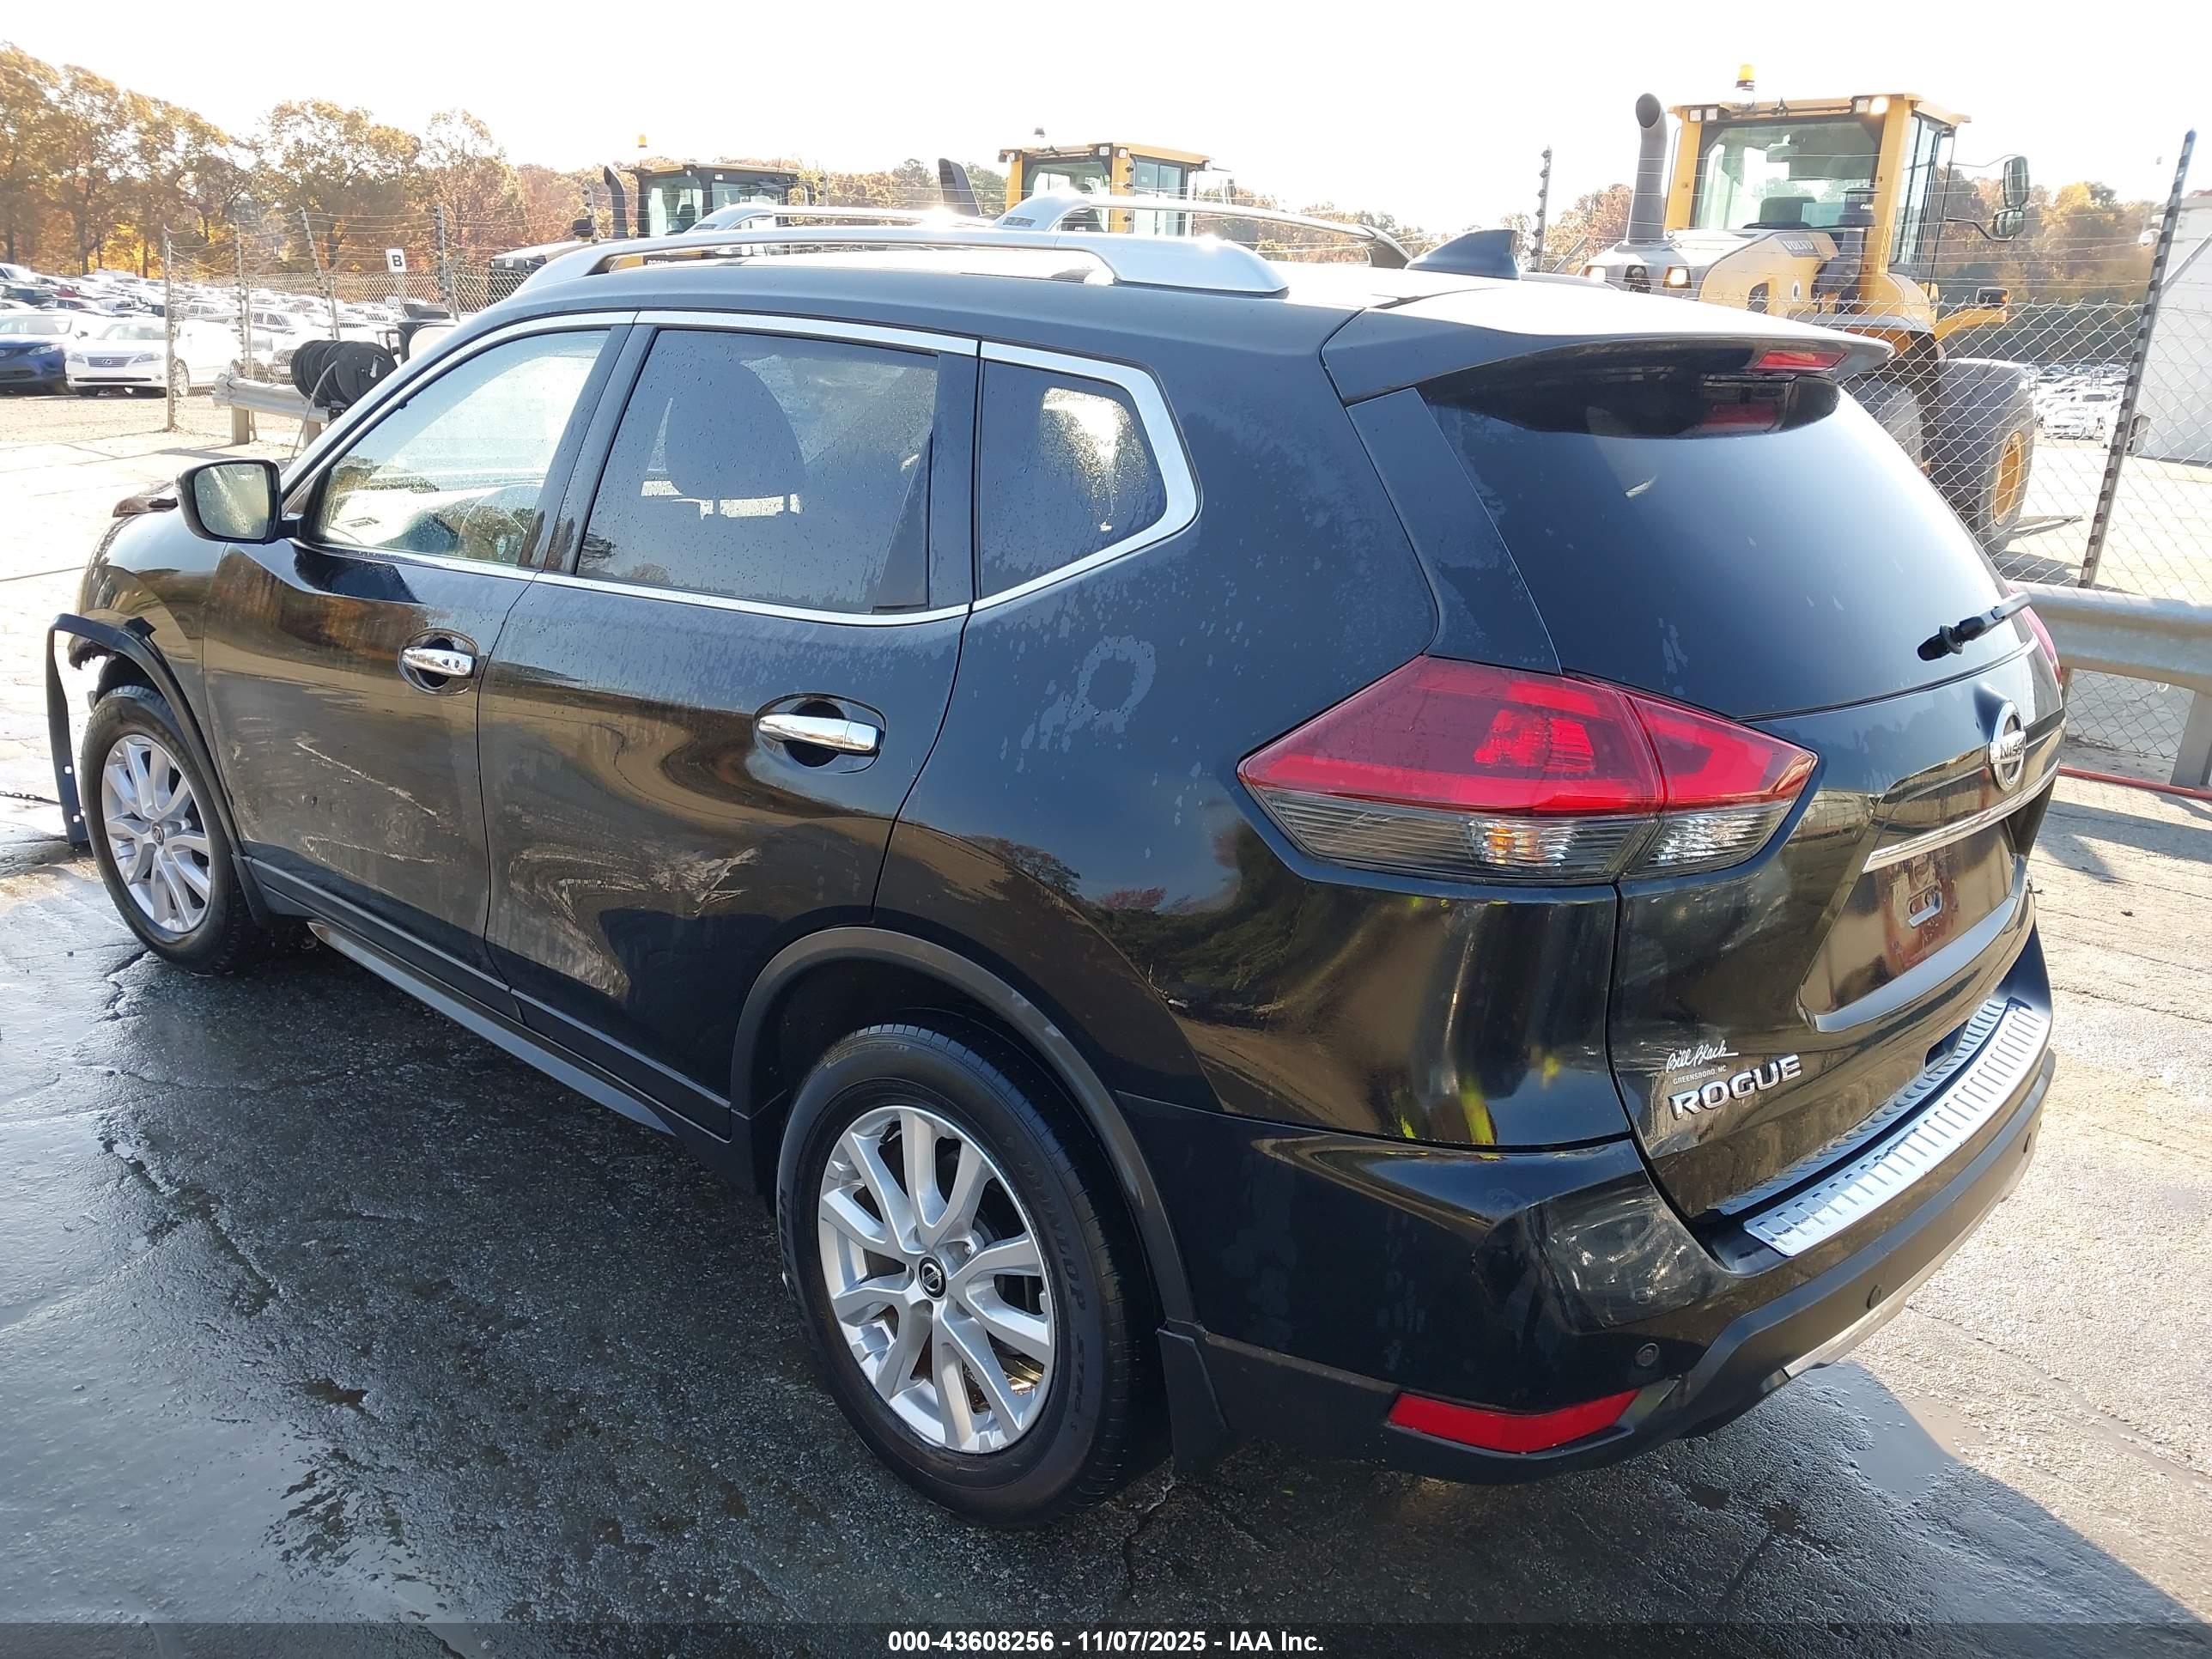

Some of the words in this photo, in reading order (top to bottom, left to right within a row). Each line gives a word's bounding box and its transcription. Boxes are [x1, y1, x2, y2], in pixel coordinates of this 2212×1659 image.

[1782, 240, 1814, 251] VOLVO
[392, 255, 403, 266] B
[1666, 1048, 1692, 1073] Bill
[1692, 1039, 1740, 1066] Black
[1673, 1068, 1717, 1085] GREENSBORO,
[1717, 1065, 1728, 1073] NC
[1668, 1054, 1802, 1121] ROGUE
